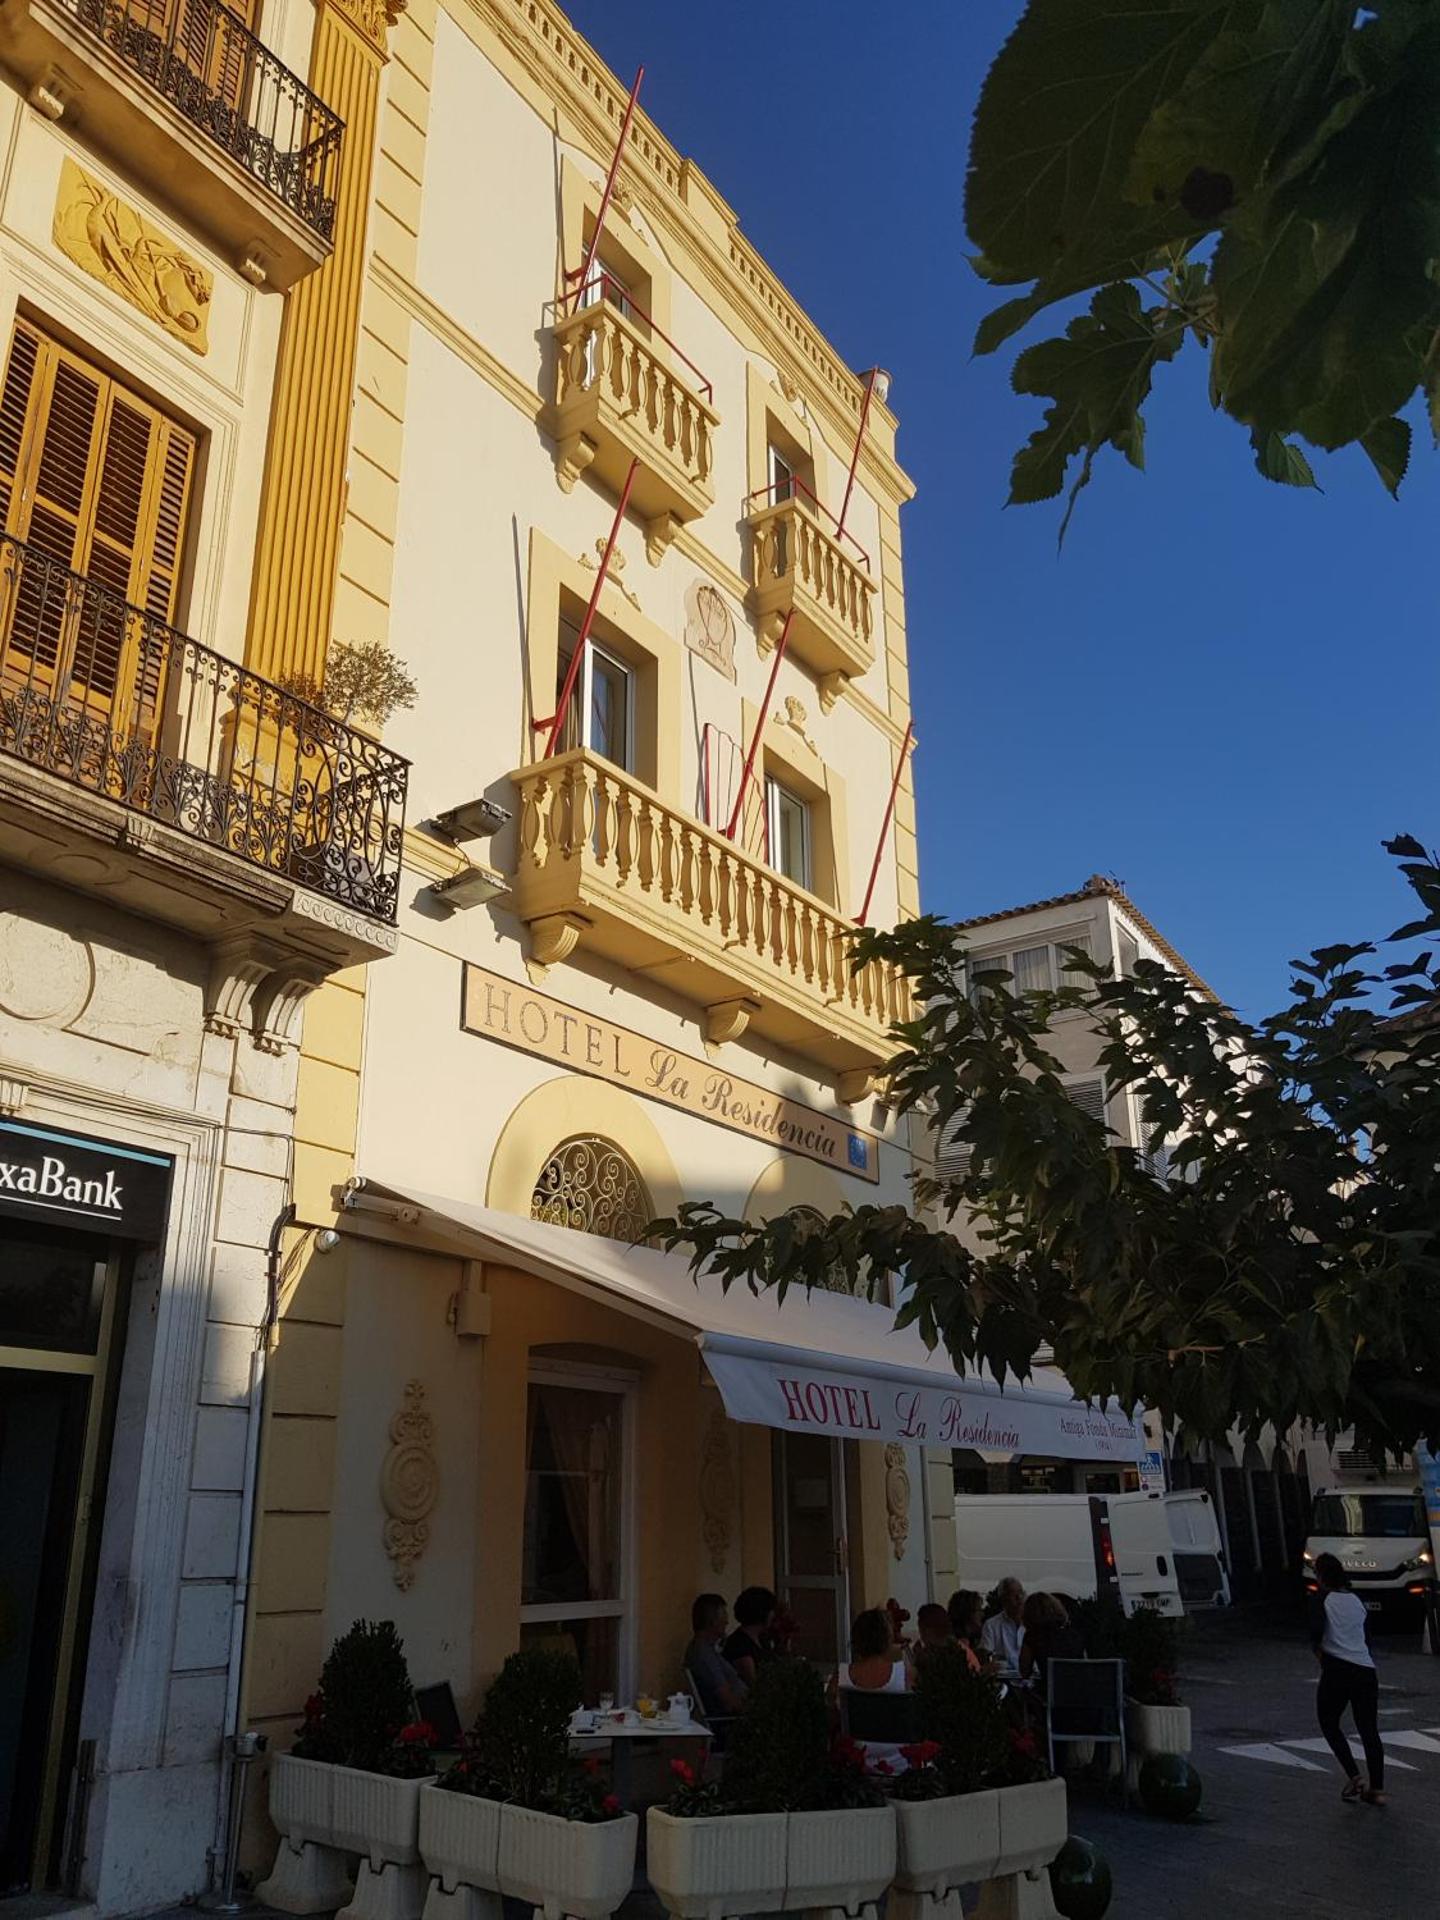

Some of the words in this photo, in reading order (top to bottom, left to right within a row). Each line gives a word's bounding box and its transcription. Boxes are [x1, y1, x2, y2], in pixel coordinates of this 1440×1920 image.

[485, 982, 631, 1077] HOTEL
[645, 1049, 690, 1100] La
[701, 1073, 838, 1158] Residencia
[777, 1379, 881, 1431] HOTEL
[895, 1391, 927, 1439] La
[939, 1396, 1020, 1449] Residencia
[1342, 1559, 1377, 1568] IVECO
